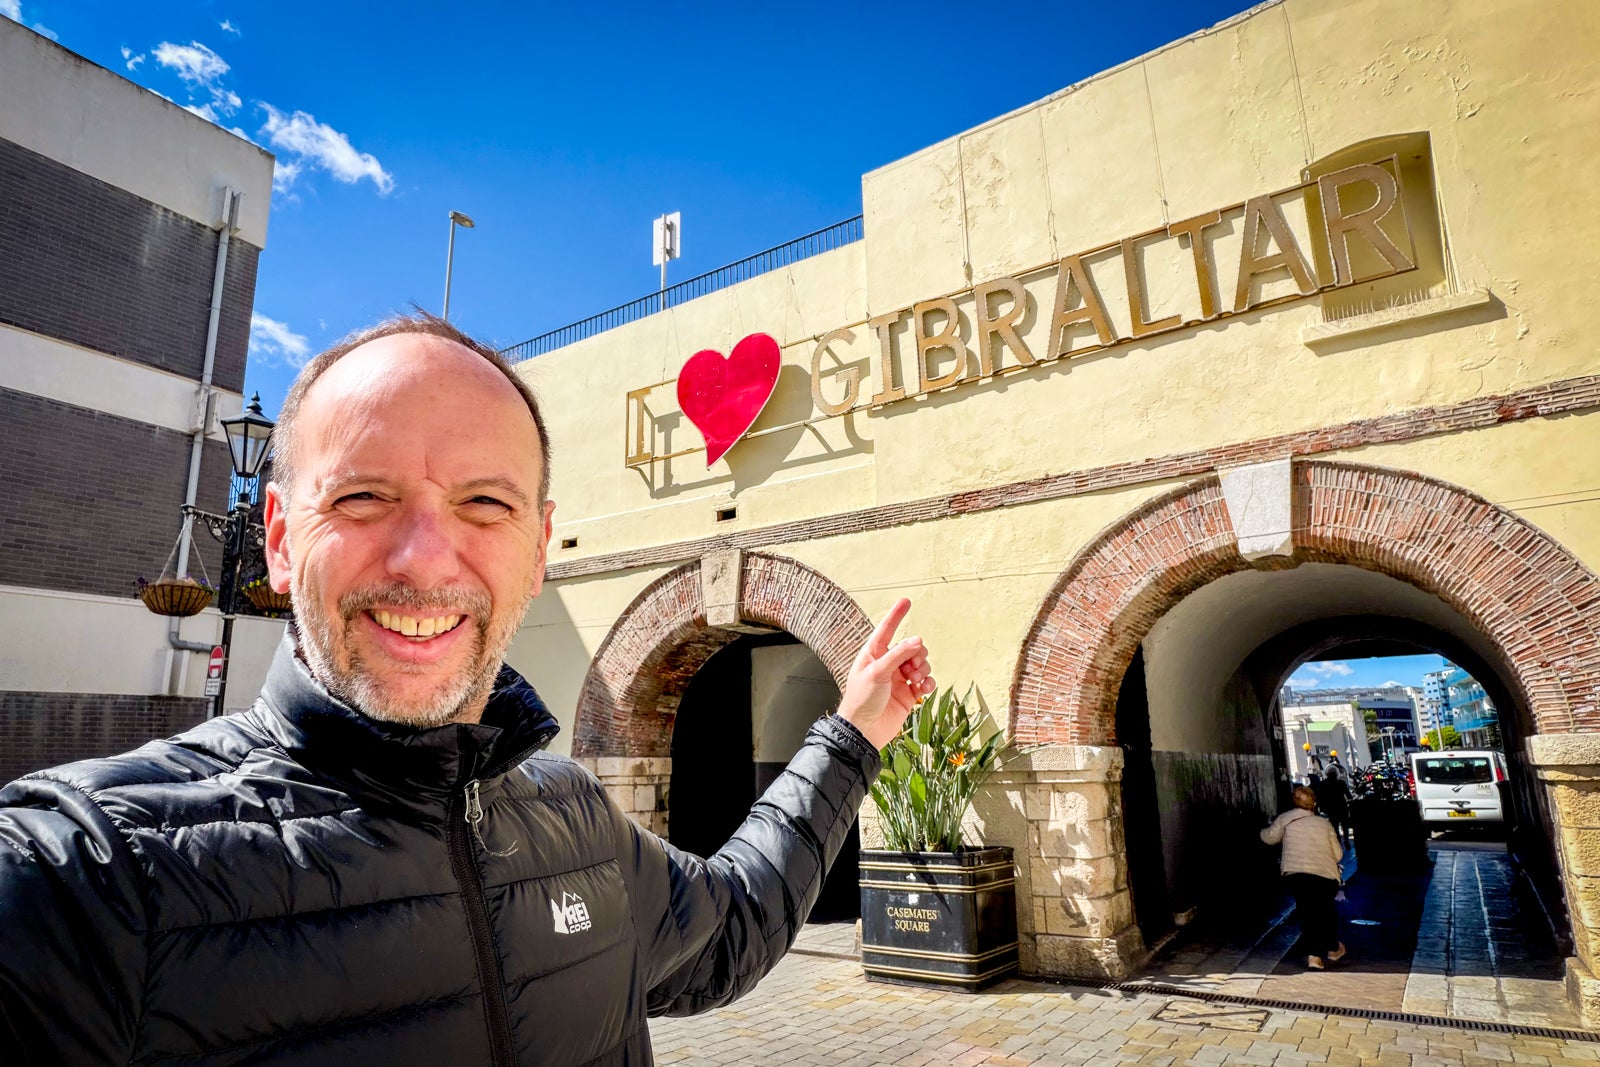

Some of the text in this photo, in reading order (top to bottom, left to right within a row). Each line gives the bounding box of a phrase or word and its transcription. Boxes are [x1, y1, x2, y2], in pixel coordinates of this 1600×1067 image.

[627, 164, 1415, 465] I GIBRALTAR
[565, 902, 590, 925] REI
[887, 906, 938, 920] CASEMATES
[894, 920, 930, 933] SQUARE
